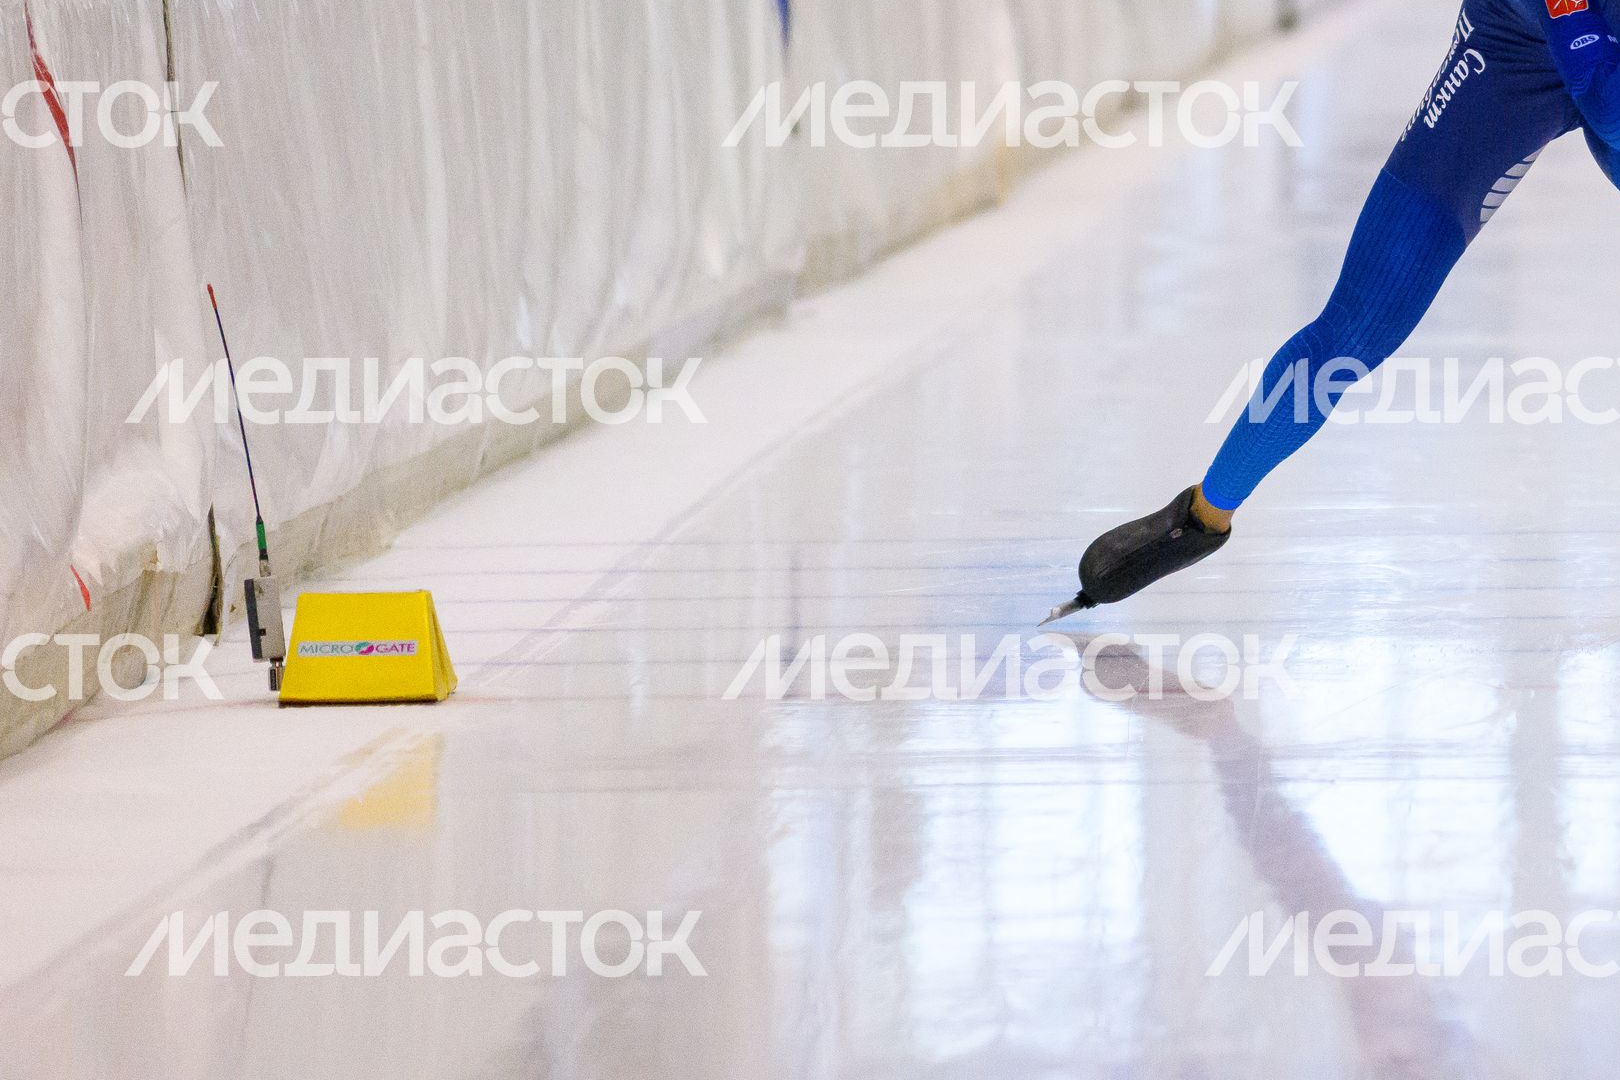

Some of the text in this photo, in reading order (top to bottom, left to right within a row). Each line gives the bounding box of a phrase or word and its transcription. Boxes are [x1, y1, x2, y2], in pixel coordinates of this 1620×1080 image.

[1423, 48, 1486, 129] Санкт
[301, 642, 415, 655] MICRO GATE
